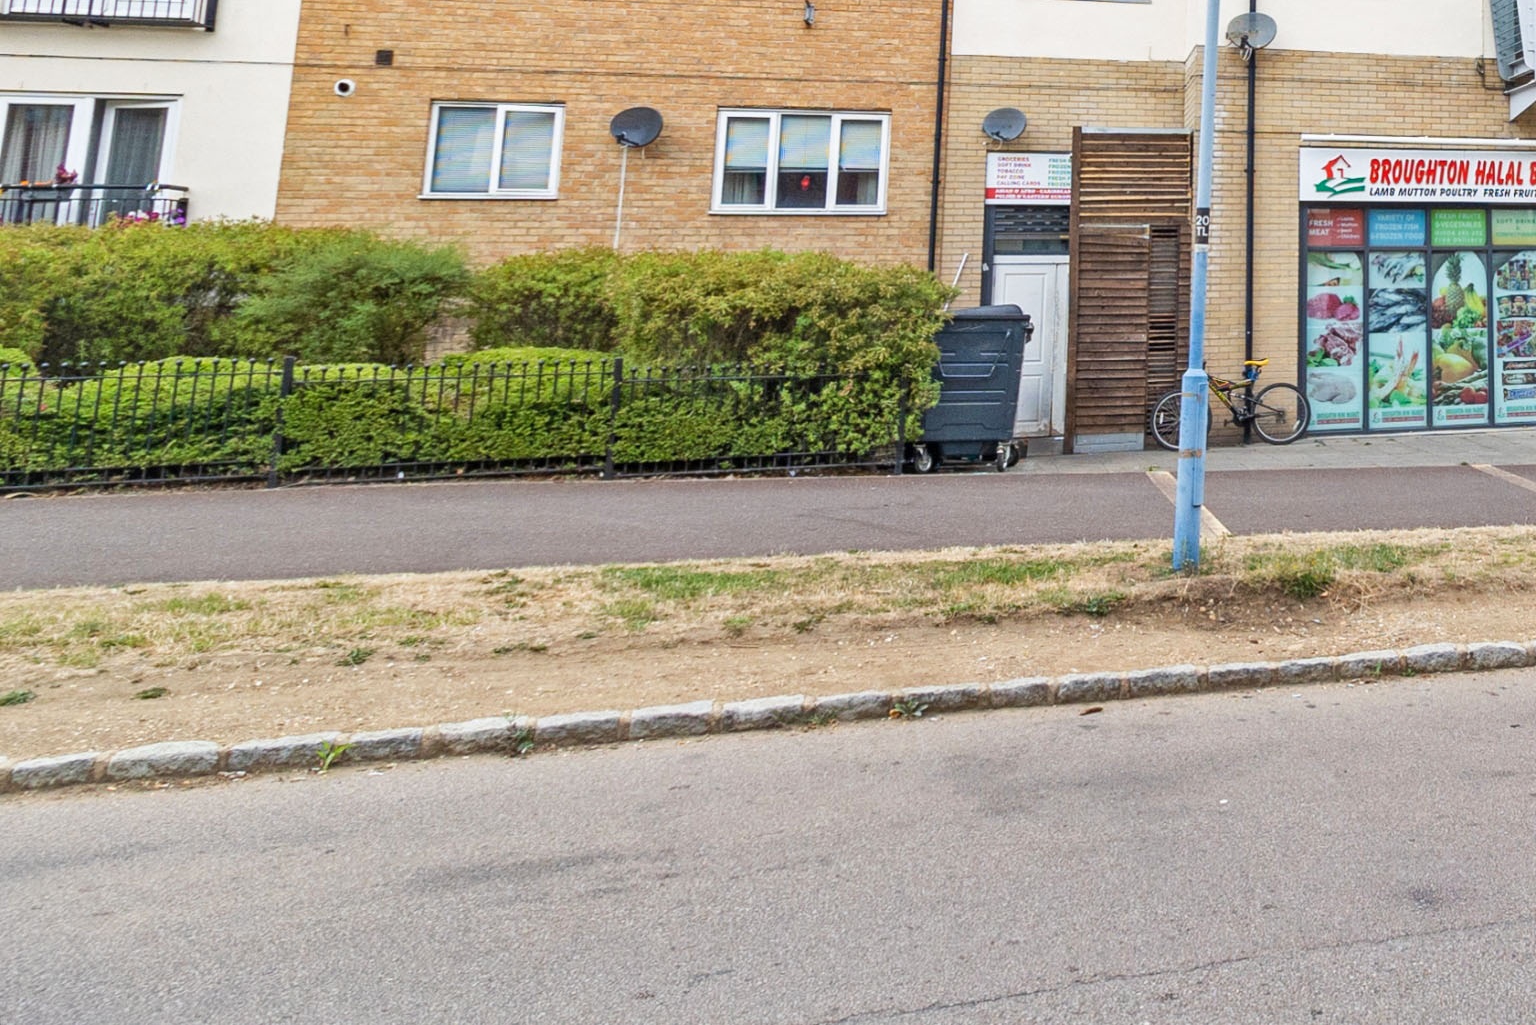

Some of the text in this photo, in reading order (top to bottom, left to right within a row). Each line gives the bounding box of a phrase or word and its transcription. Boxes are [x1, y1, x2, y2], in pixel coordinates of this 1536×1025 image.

[1369, 158, 1470, 186] BROUGHTON
[1475, 160, 1523, 186] HALAL
[1369, 187, 1396, 196] LAMB
[1398, 187, 1436, 197] MUTTON
[1440, 188, 1478, 197] POULTRY
[1483, 188, 1511, 197] FRESH
[1196, 216, 1210, 226] 20
[1197, 226, 1208, 236] TL
